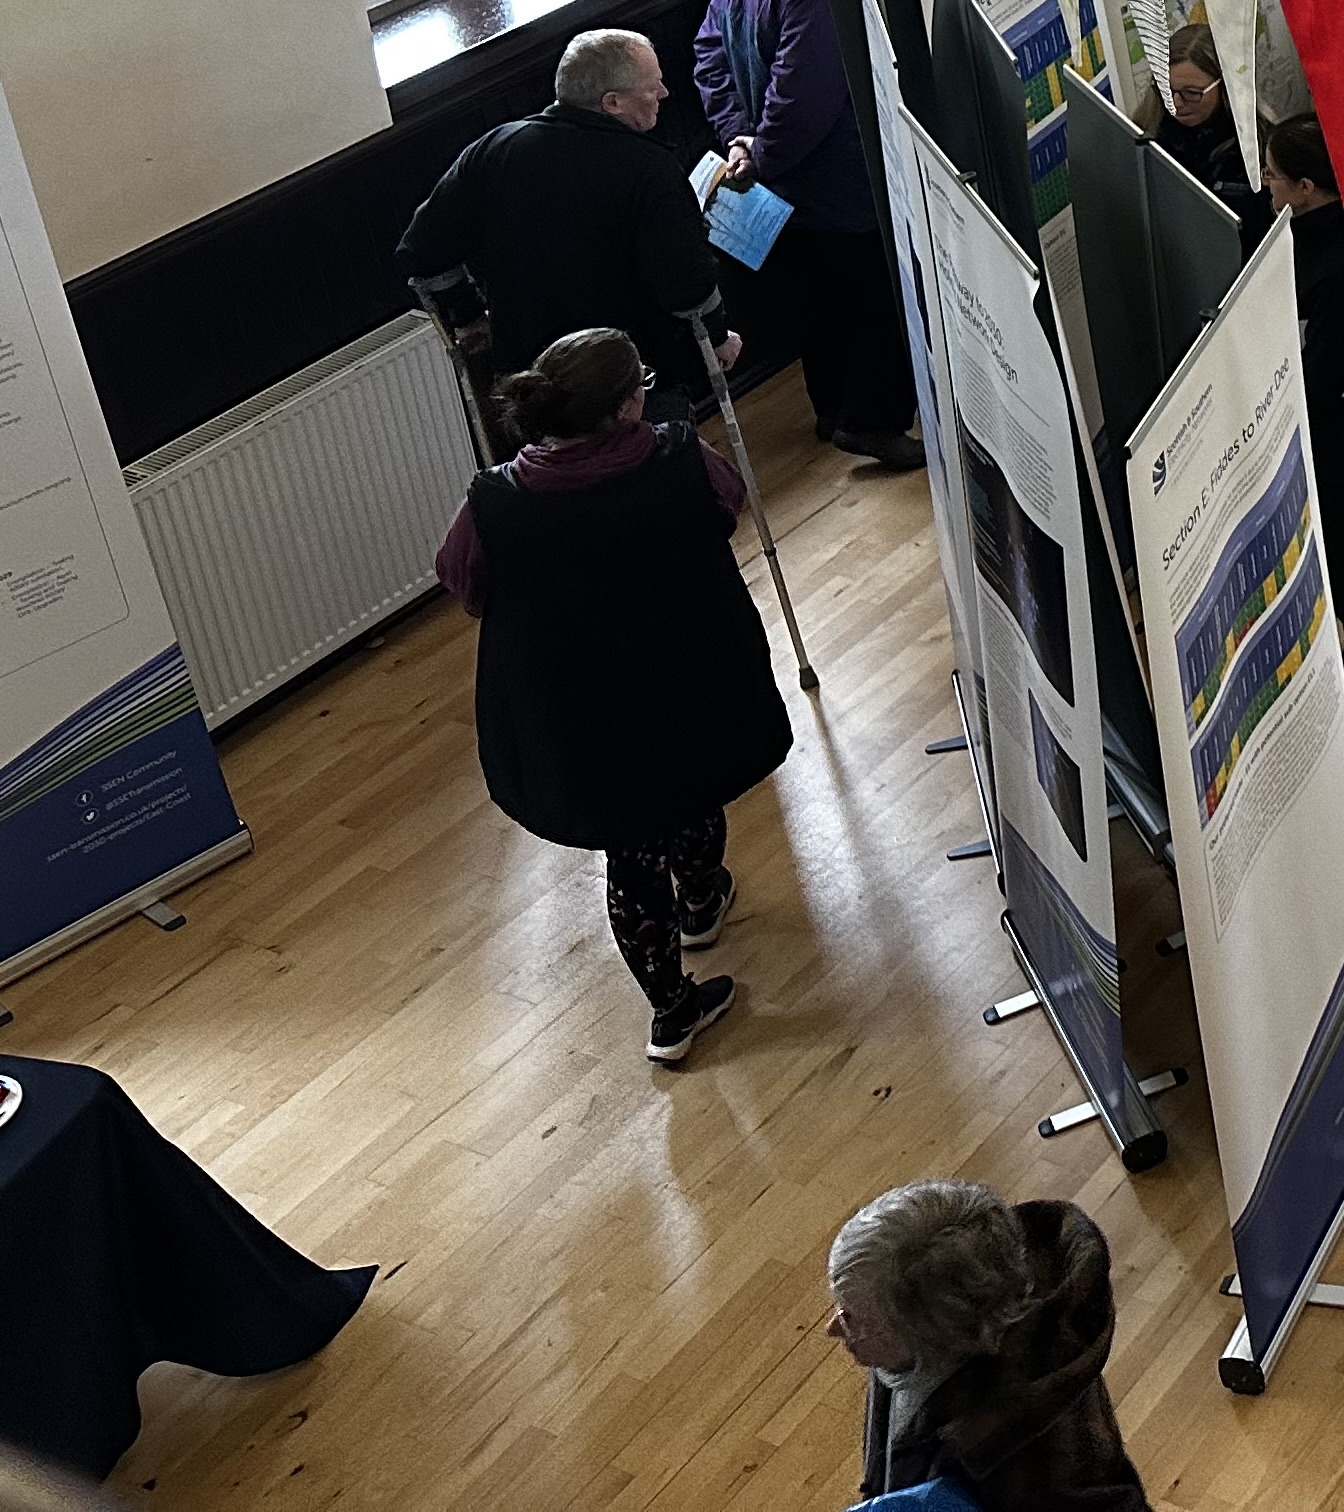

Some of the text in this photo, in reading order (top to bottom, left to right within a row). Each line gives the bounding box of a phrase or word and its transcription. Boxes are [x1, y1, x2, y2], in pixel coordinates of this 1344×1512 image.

[1164, 505, 1202, 571] Section
[1210, 439, 1240, 493] Fiddes
[1242, 422, 1254, 444] to
[1255, 385, 1275, 426] River
[1274, 357, 1290, 391] Dee
[101, 750, 177, 793] SSEN Community
